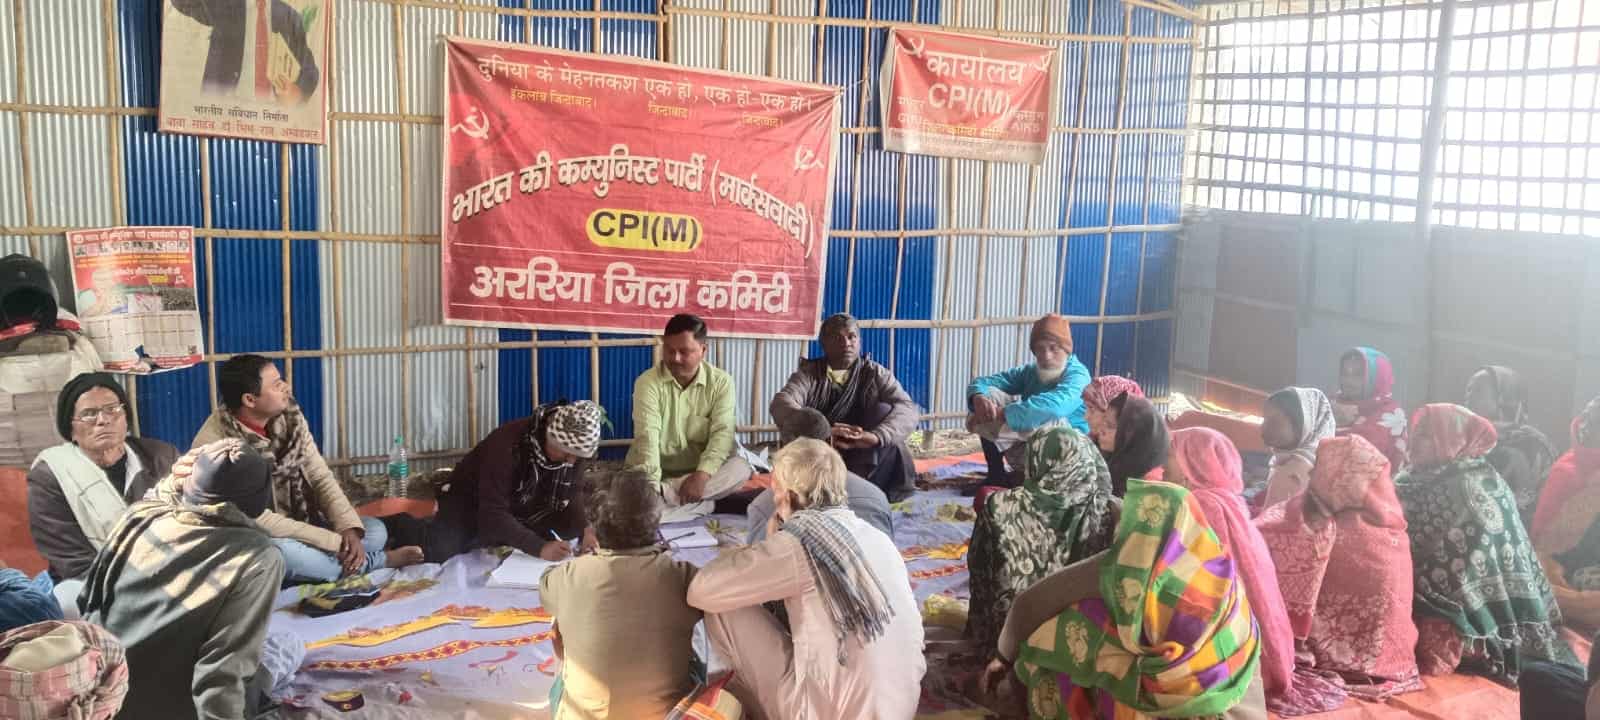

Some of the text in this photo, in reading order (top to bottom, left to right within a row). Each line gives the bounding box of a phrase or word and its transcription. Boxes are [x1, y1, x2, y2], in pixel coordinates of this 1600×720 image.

[478, 57, 529, 83] दुनिया
[537, 60, 554, 82] के
[560, 64, 639, 94] मेहनतकश
[643, 77, 673, 99] एक
[704, 86, 731, 107] एक
[927, 49, 1027, 85] कार्यालय
[928, 82, 1011, 118] CPI(M)
[452, 174, 512, 223] भारत
[519, 150, 551, 195] की
[557, 143, 660, 198] कम्युनिस्ट
[664, 154, 704, 192] पार्टी
[591, 210, 699, 249] CPI(M)
[469, 255, 793, 314] अररिया जिला कमिटी
